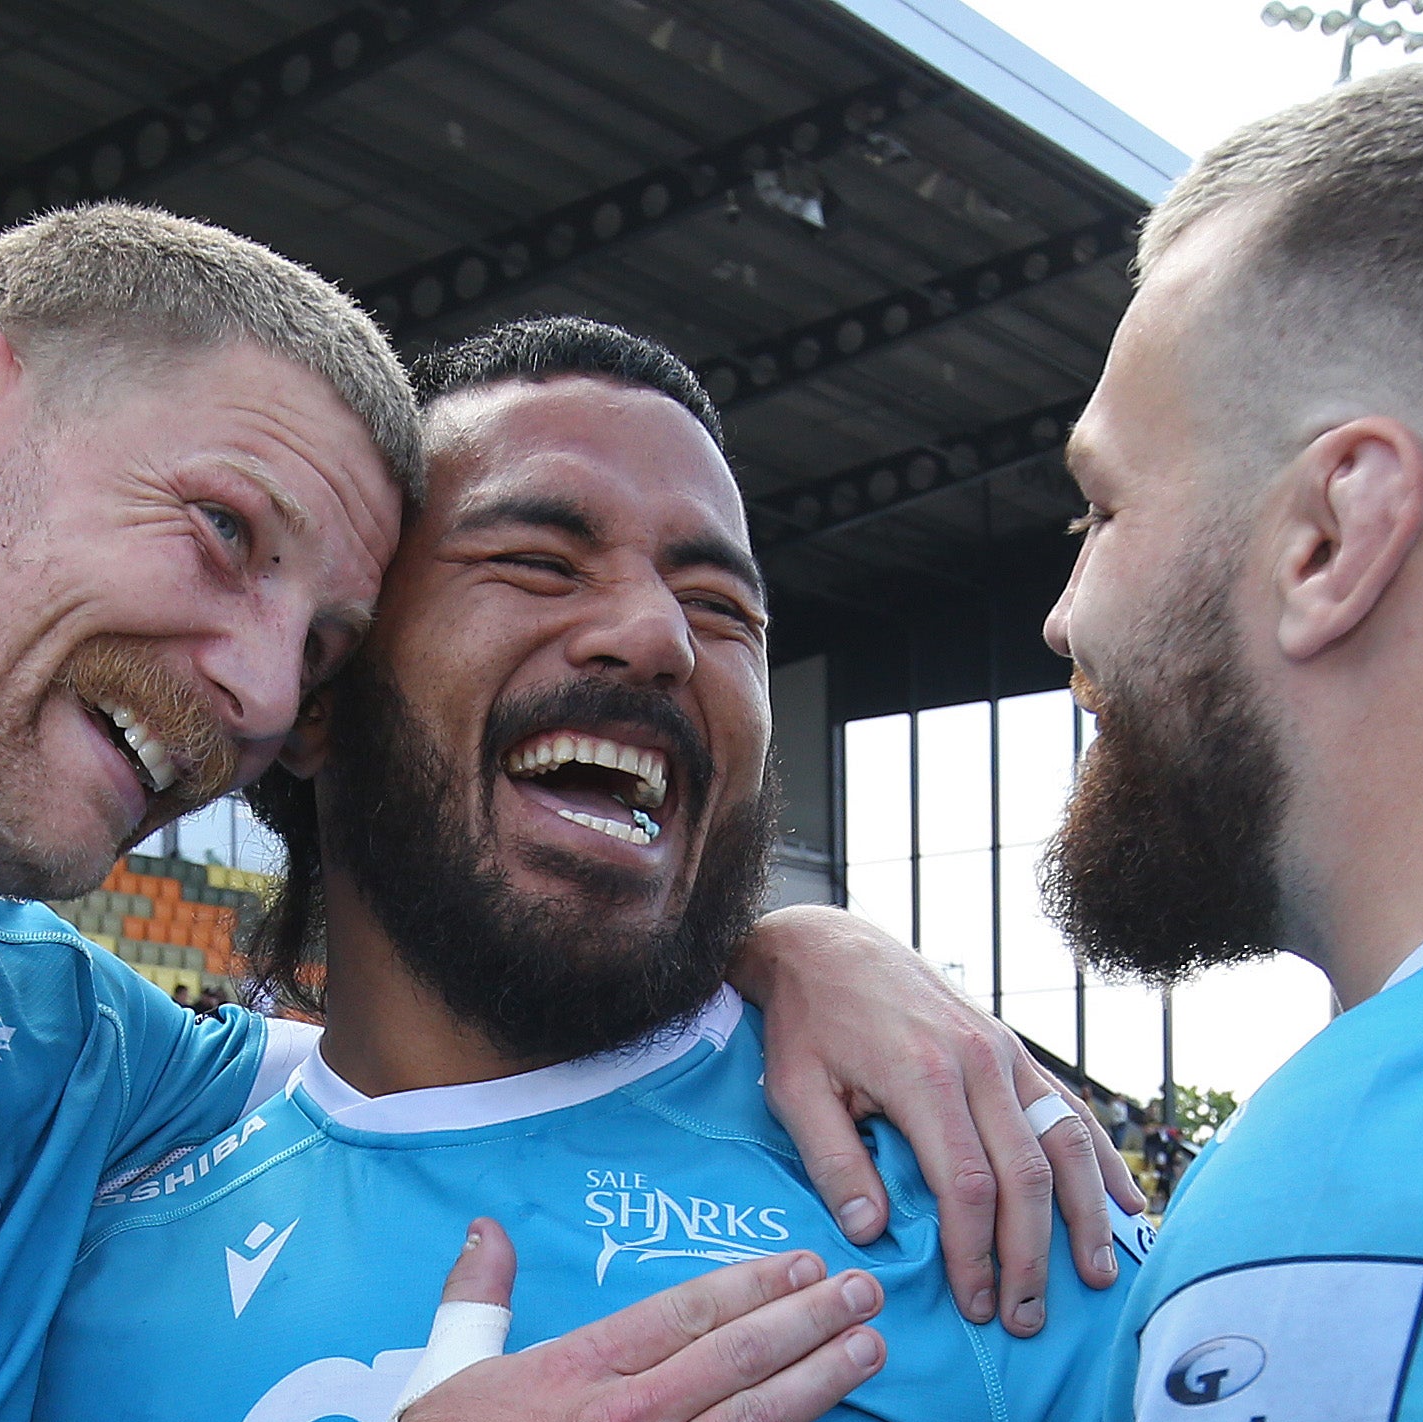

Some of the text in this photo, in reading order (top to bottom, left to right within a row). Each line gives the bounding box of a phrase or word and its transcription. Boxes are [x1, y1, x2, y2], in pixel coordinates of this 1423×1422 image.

[93, 1115, 268, 1207] OSHIBA
[585, 1169, 648, 1190] SALE
[583, 1187, 791, 1243] SHARKS
